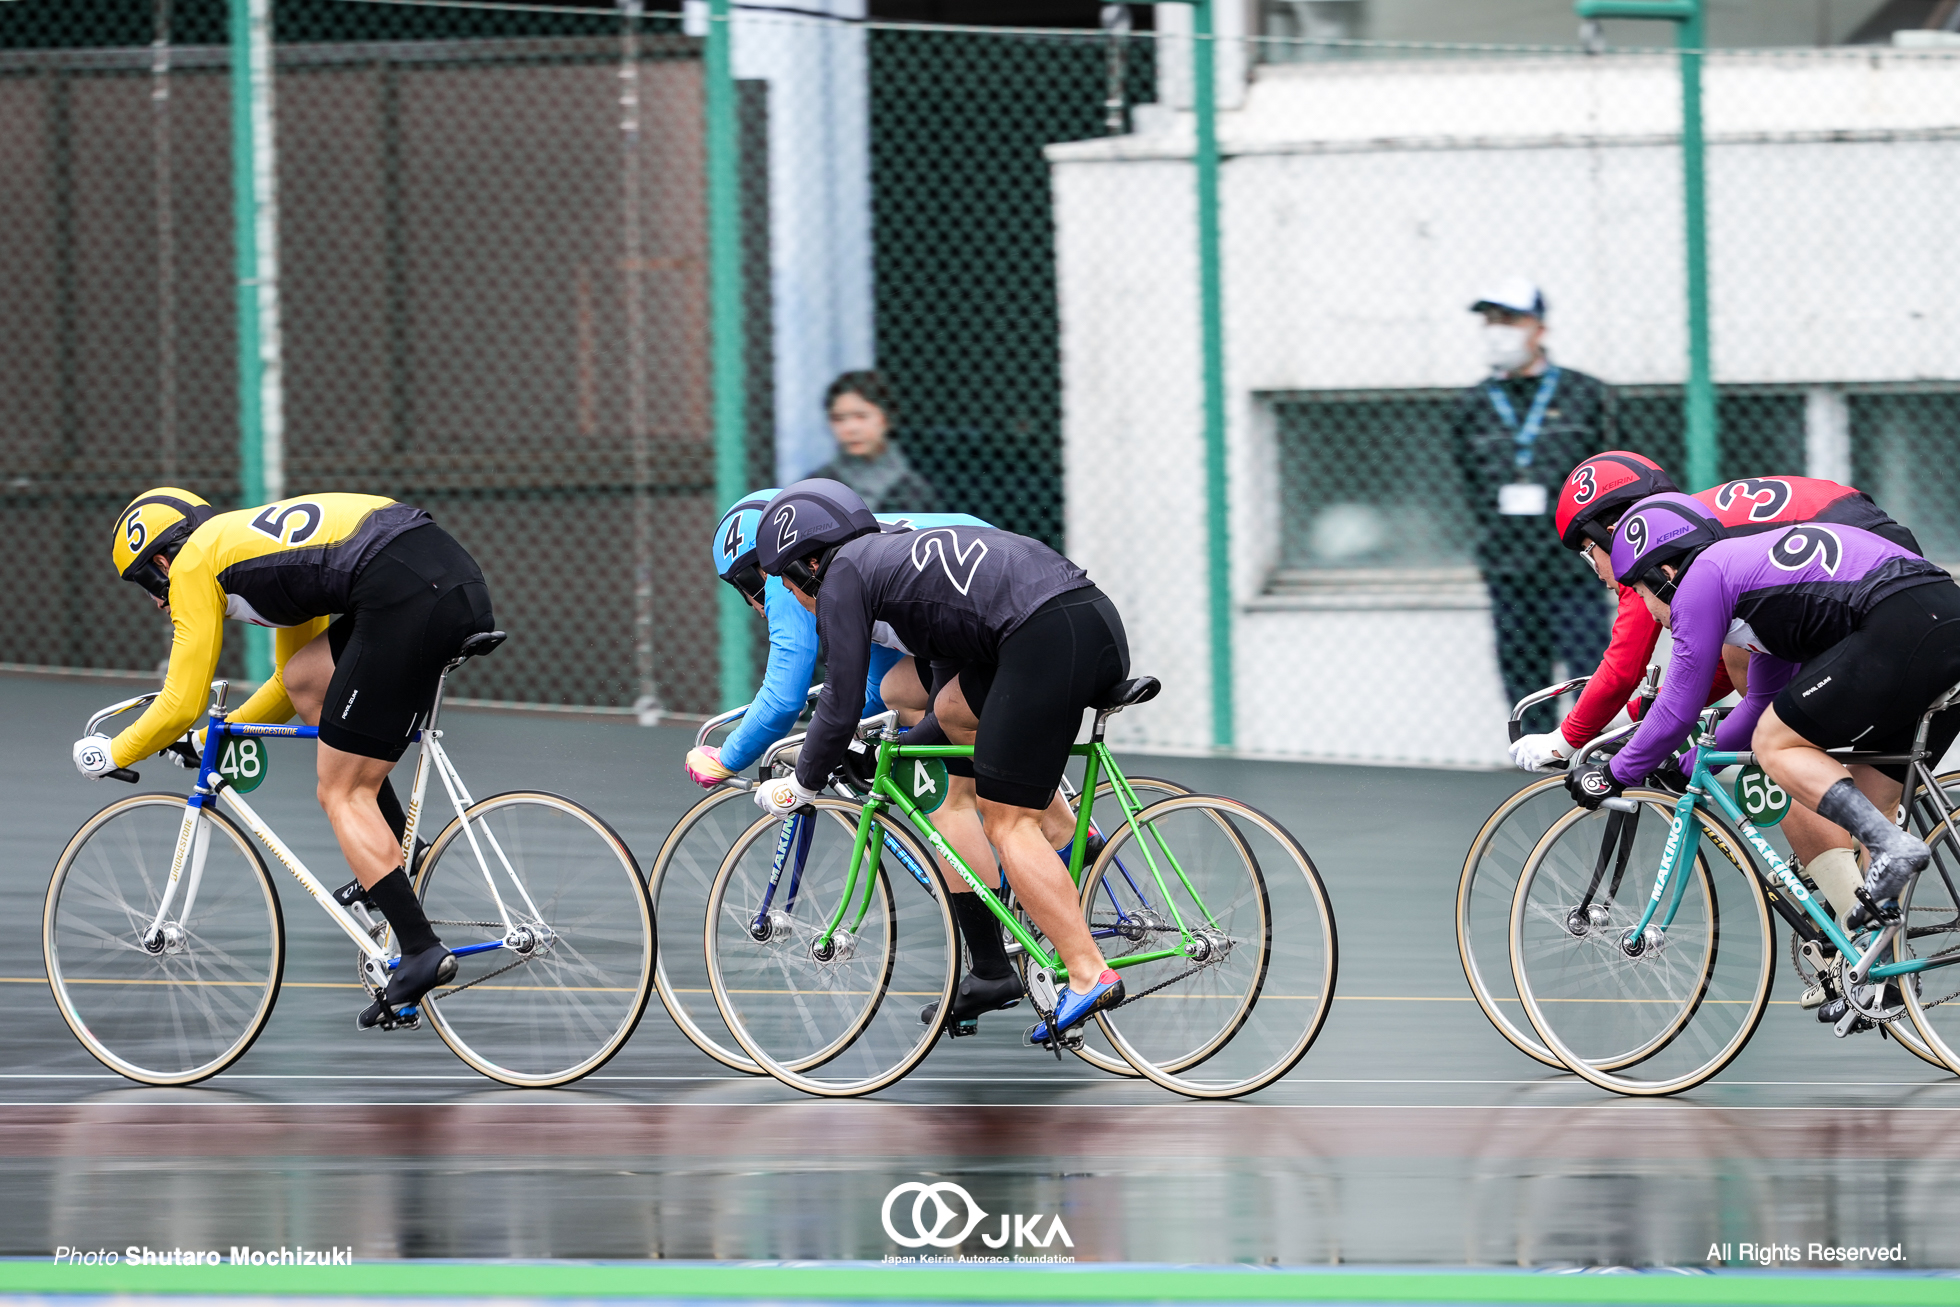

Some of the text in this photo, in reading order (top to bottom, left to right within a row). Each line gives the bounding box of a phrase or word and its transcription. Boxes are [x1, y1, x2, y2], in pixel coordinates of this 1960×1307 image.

[1571, 465, 1597, 504] 3
[1601, 475, 1633, 493] KEIRIN
[1715, 478, 1792, 521] 3
[126, 507, 146, 554] 5
[151, 515, 180, 538] KEIRIN
[246, 501, 324, 547] 5
[723, 511, 745, 562] 4
[773, 504, 798, 553] 2
[800, 522, 834, 539] KEIRIN
[1625, 514, 1649, 560] 9
[1656, 525, 1690, 544] KEIRIN
[911, 528, 989, 596] 2
[1768, 524, 1843, 578] 9
[242, 725, 299, 736] BRIDGESTONE
[219, 739, 261, 780] 48
[913, 759, 937, 798] 4
[1742, 772, 1787, 815] 58
[170, 817, 193, 882] BRIDGESTONE
[254, 826, 319, 900] BRIDGESTONE
[770, 814, 797, 886] MAKIN
[928, 830, 990, 902] Panasonic
[1651, 816, 1683, 902] MAKINO
[1742, 824, 1810, 902] MAKINO
